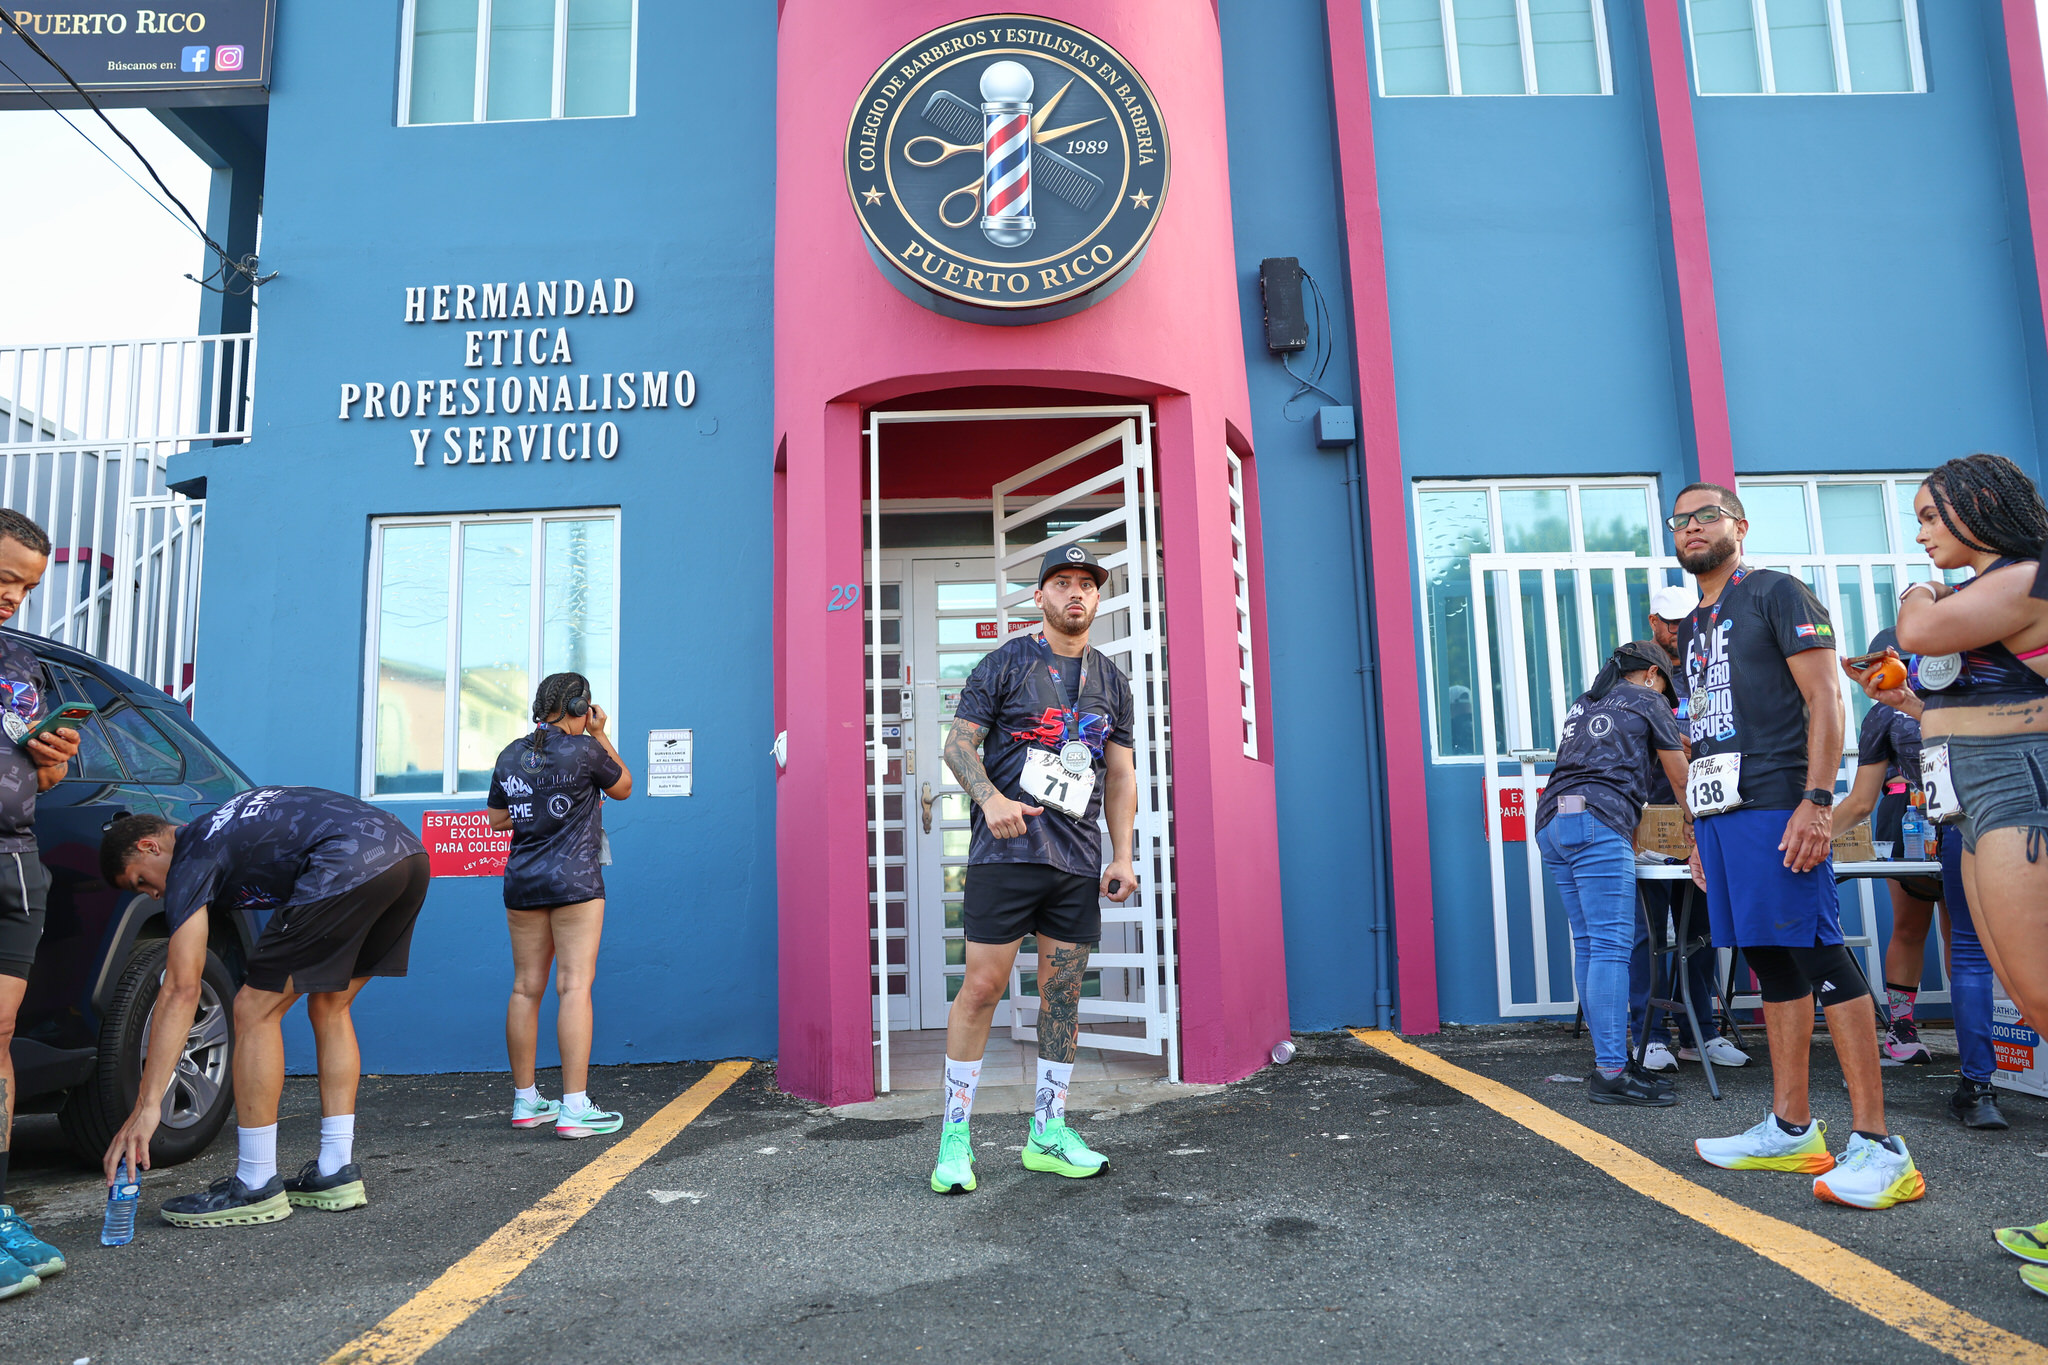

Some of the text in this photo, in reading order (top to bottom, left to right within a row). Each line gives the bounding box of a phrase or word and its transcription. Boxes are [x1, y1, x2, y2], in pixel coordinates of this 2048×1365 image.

[12, 9, 206, 35] PUERTO RICO
[107, 60, 177, 71] Búscanos en:
[859, 28, 1157, 171] COLEGIO DE BARBEROS Y ESTILISTAS EN BARBERÍA
[1066, 140, 1109, 154] 1989
[900, 239, 1113, 294] PUERTO RICO
[404, 277, 635, 323] HERMANDAD
[464, 326, 572, 367] ETICA
[338, 369, 696, 419] PROFESIONALISMO
[410, 421, 619, 466] Y SERVICIO
[826, 583, 860, 612] 29
[655, 765, 685, 773] AVISO
[1697, 757, 1716, 769] FADE
[1705, 765, 1723, 776] RUN
[1044, 774, 1069, 802] 71
[1692, 780, 1725, 808] 138
[1925, 781, 1941, 810] 2
[427, 815, 490, 827] ESTACION
[435, 842, 464, 853] PARA
[463, 861, 477, 871] LEY
[2010, 1057, 2031, 1068] PAPER
[2011, 1048, 2028, 1058] 2-PLY
